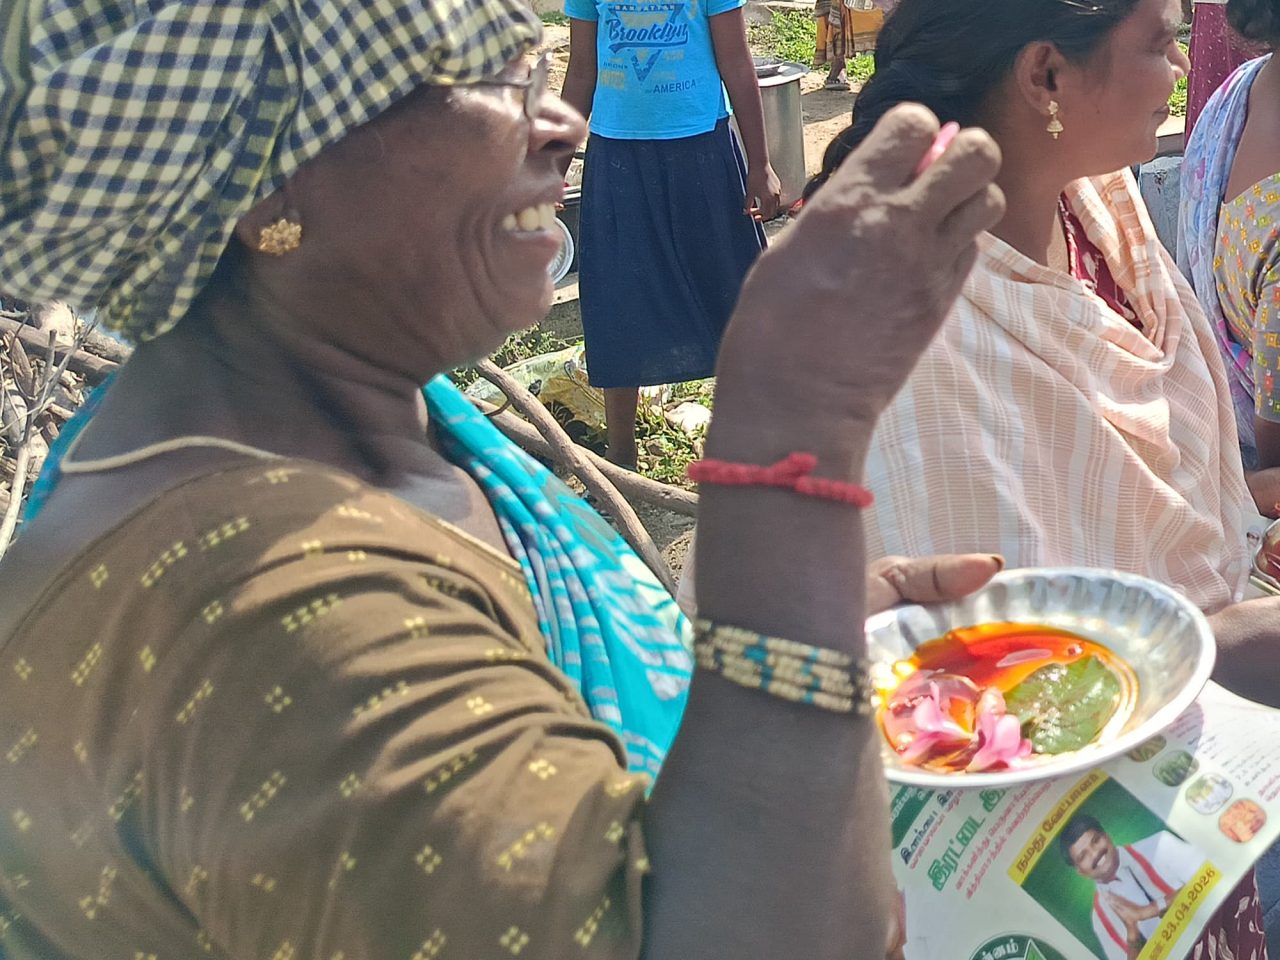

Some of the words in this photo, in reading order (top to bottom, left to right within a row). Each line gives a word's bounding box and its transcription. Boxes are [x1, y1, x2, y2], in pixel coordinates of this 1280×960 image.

[606, 18, 688, 47] Brooklyn
[653, 79, 697, 94] AMERICA
[928, 816, 986, 891] இரட்டை
[1015, 833, 1046, 874] நமது
[1162, 867, 1217, 941] 23.04.2026
